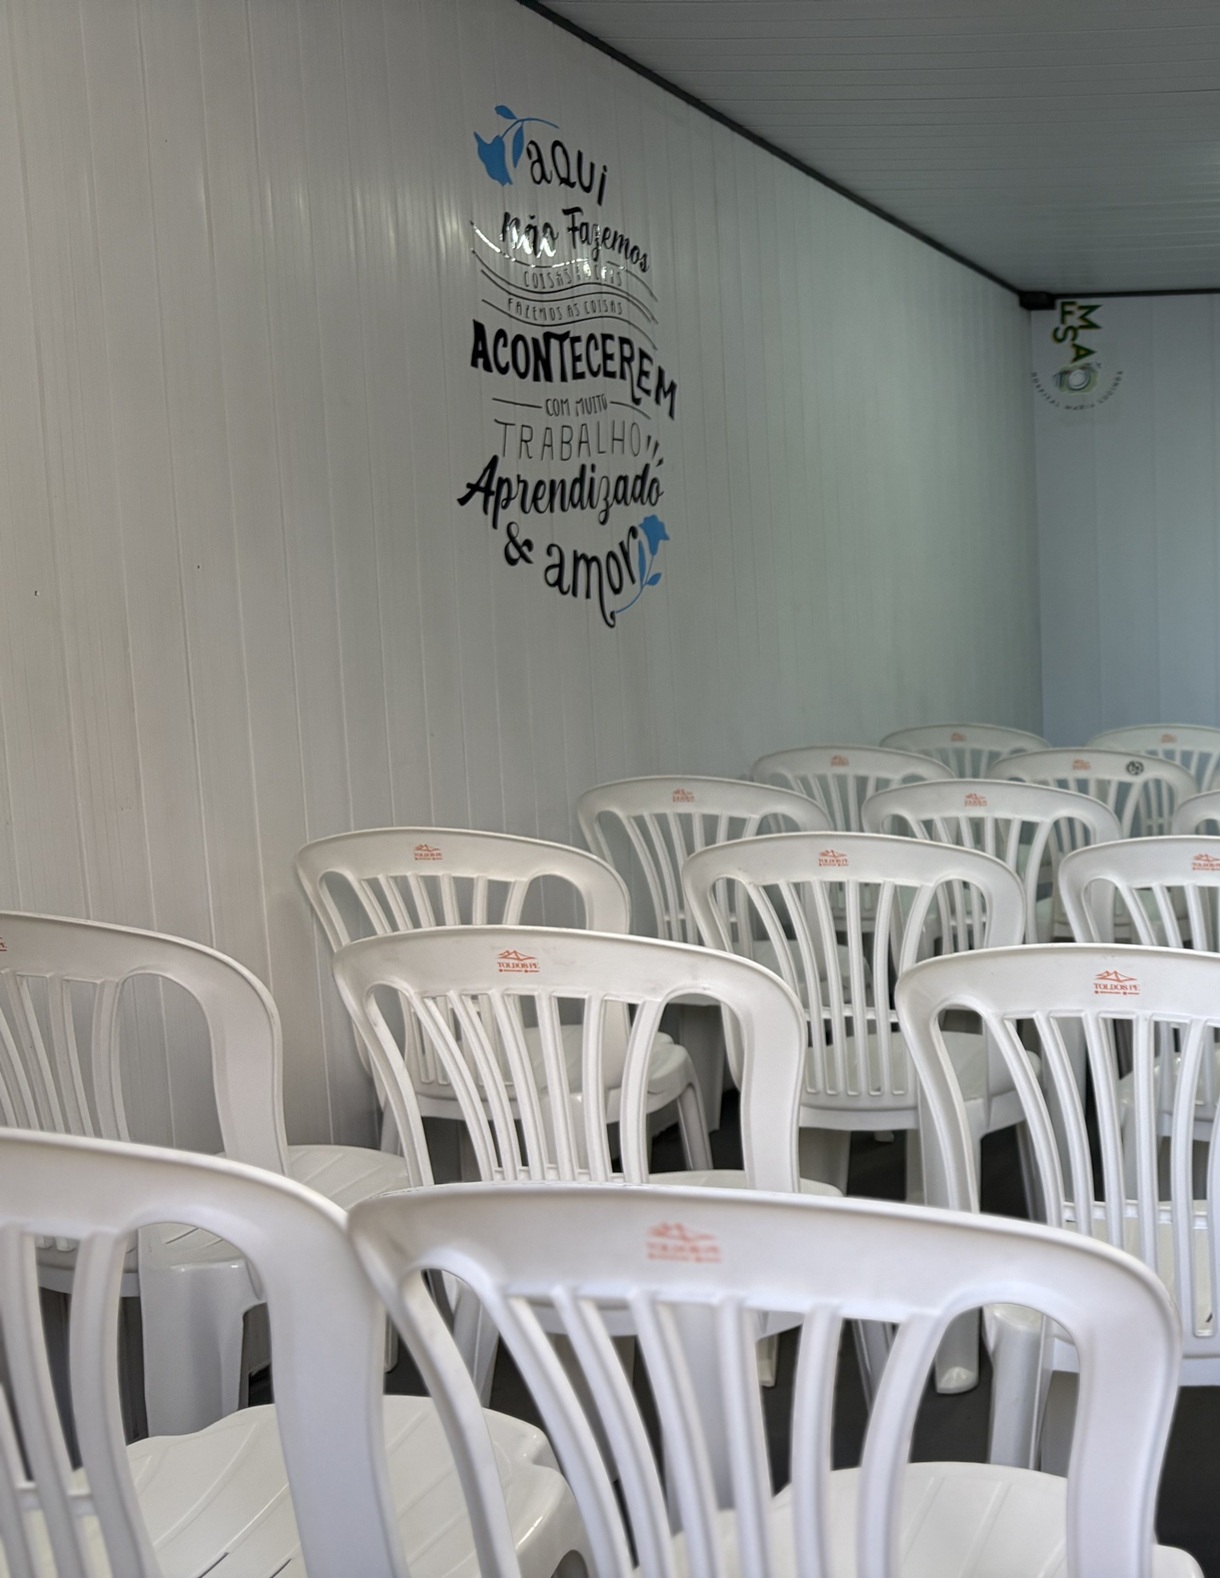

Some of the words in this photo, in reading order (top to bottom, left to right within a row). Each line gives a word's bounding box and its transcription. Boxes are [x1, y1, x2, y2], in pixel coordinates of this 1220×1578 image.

[562, 206, 650, 273] Fazemos
[524, 268, 572, 290] COISAS
[507, 297, 563, 321] FAZEMOS
[567, 302, 581, 317] AS
[585, 300, 623, 315] COISAS
[470, 318, 678, 421] ACONTECEREM
[545, 398, 570, 417] COM
[575, 394, 608, 417] MUITO
[494, 418, 641, 461] TRABALHO
[456, 454, 664, 529] Aprendizado
[504, 521, 533, 566] &
[544, 525, 638, 628] amor
[1093, 983, 1128, 991] TOLDOS
